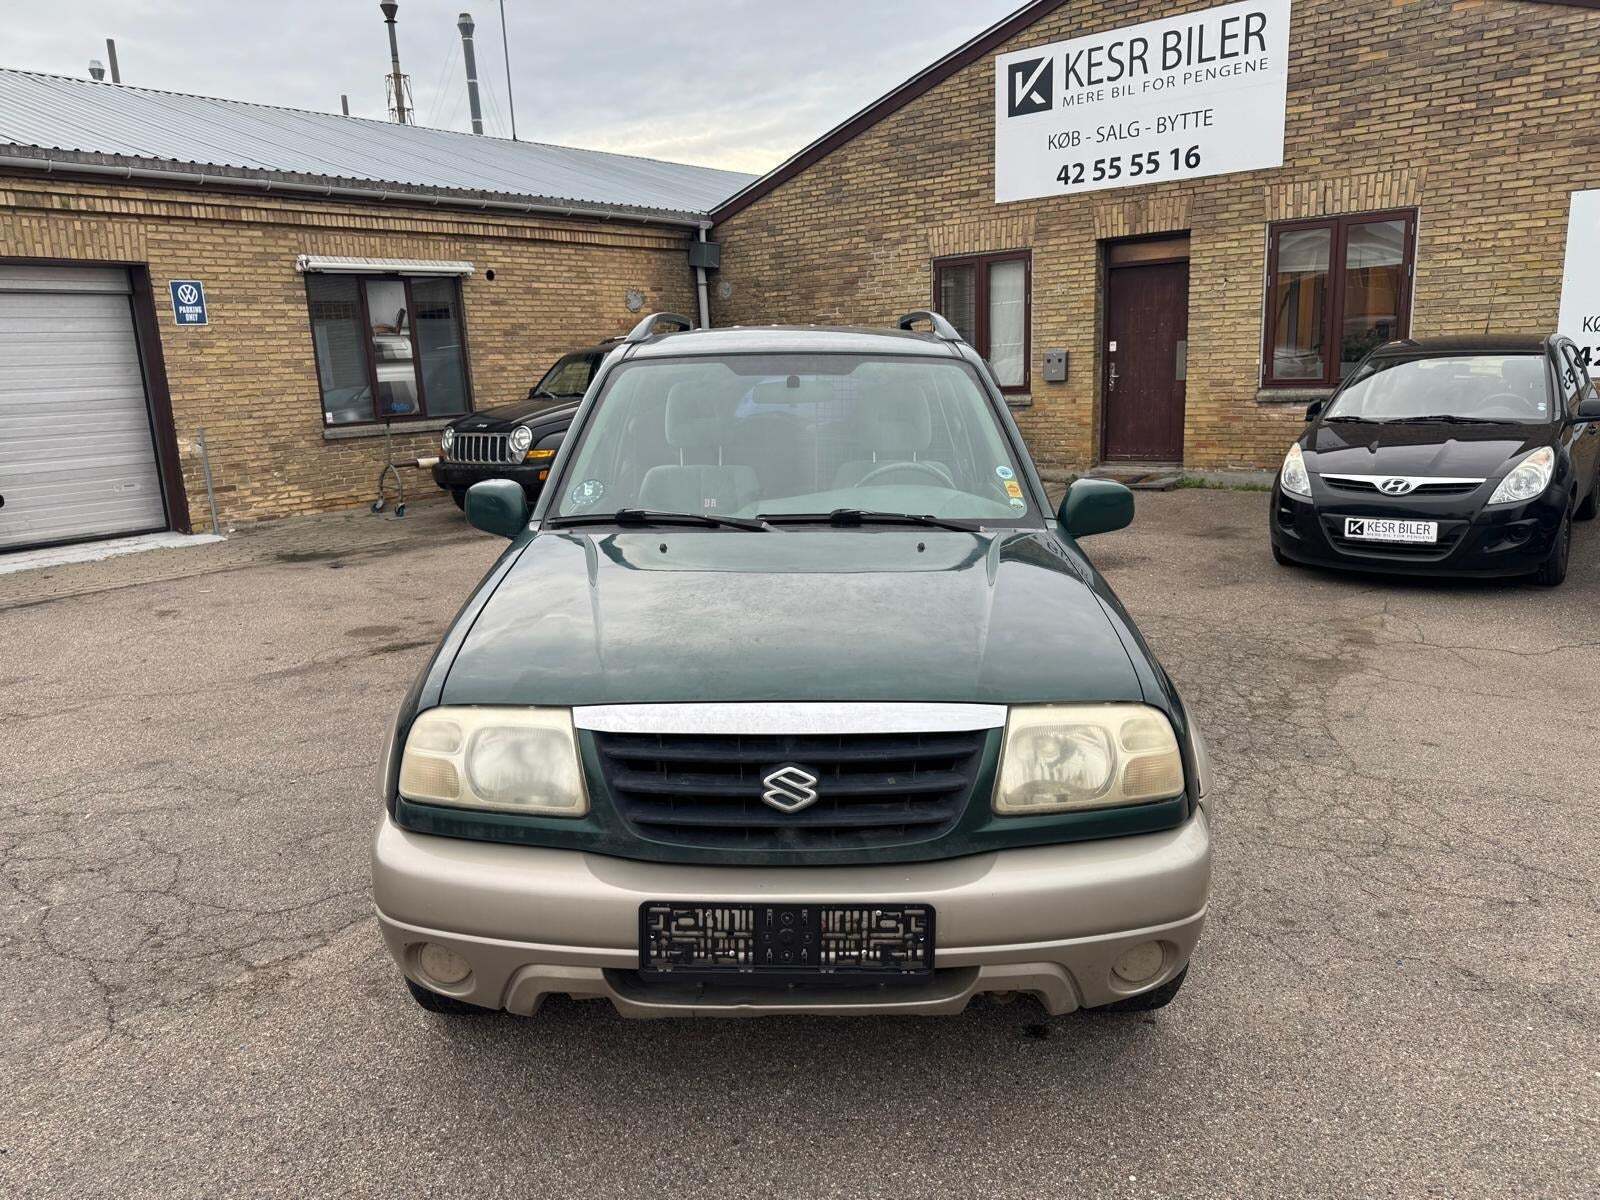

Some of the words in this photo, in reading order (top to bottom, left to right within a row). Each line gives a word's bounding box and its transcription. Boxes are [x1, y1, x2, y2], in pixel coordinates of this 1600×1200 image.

[1064, 37, 1149, 90] KESR
[1161, 12, 1267, 71] BILER
[1062, 90, 1105, 107] MERE
[1111, 85, 1136, 98] BIL
[1142, 76, 1176, 92] FOR
[1183, 57, 1270, 85] PENGENE
[1047, 130, 1082, 150] KØB
[1096, 121, 1140, 144] SALG
[1156, 109, 1214, 134] BYTTE
[1056, 162, 1085, 186] 42
[1092, 156, 1122, 182] 55
[1130, 150, 1160, 177] 55
[1169, 145, 1201, 171] 16
[1367, 521, 1395, 533] KESR
[1398, 522, 1430, 535] BILER
